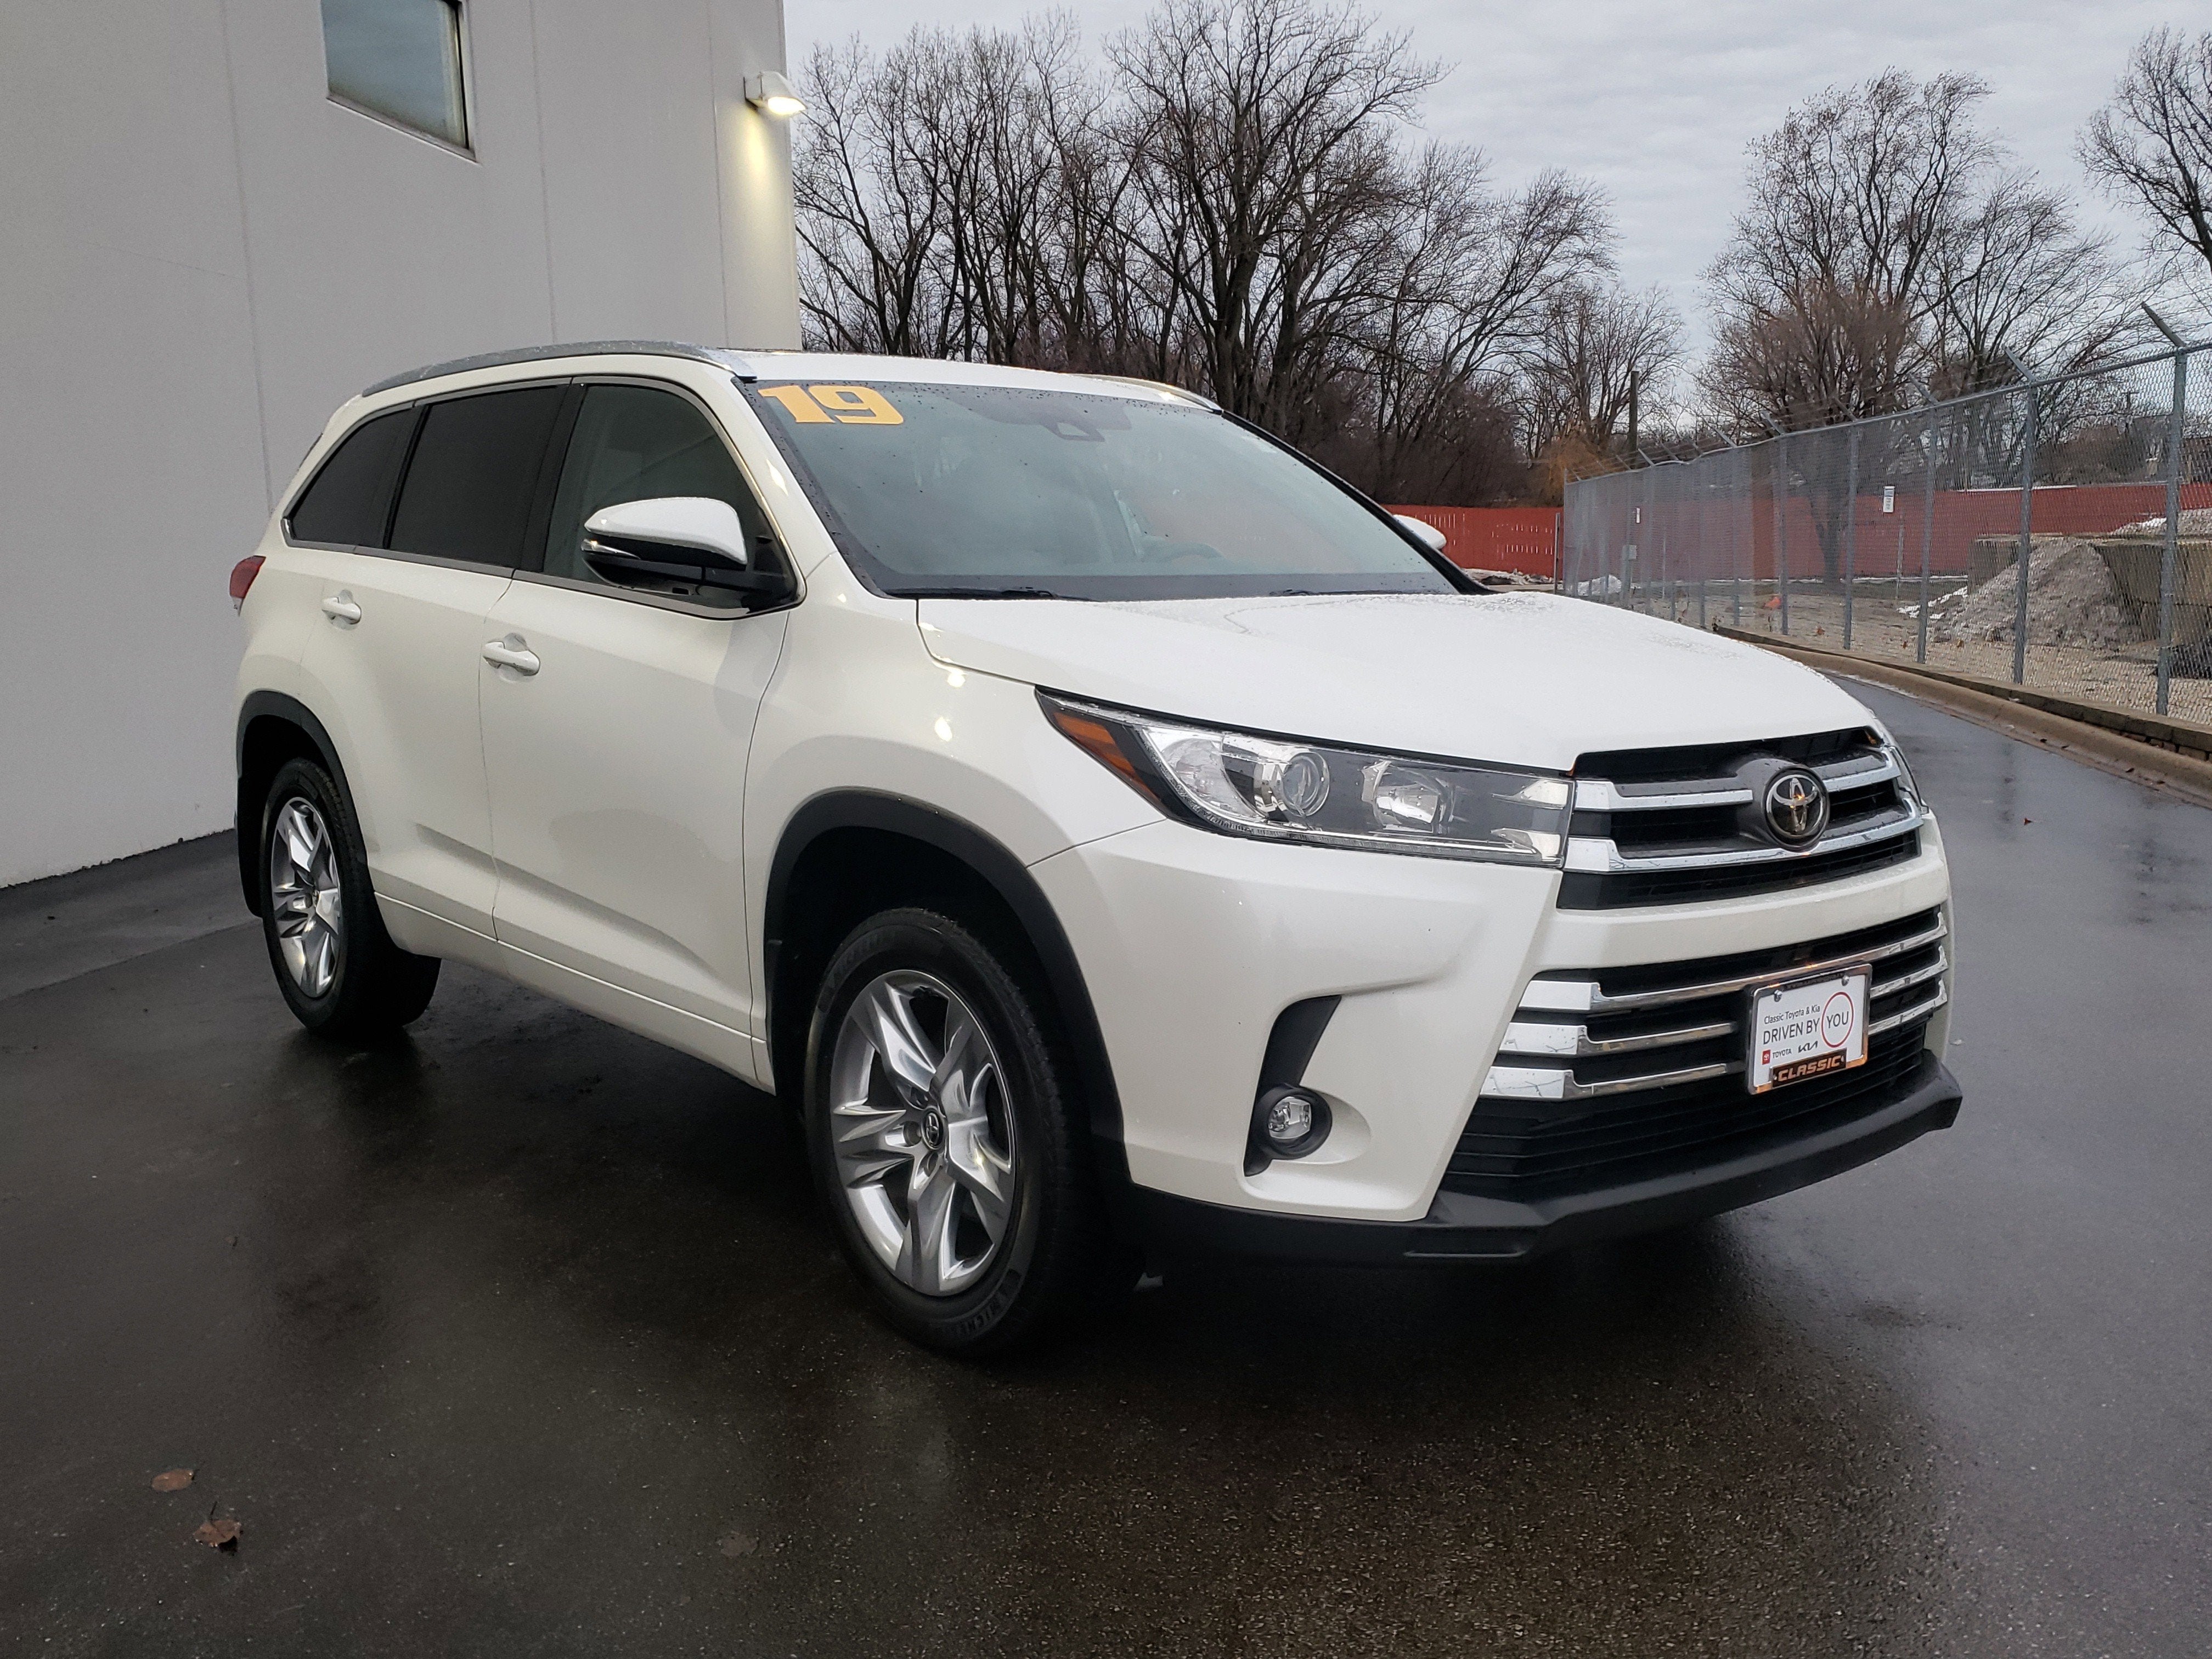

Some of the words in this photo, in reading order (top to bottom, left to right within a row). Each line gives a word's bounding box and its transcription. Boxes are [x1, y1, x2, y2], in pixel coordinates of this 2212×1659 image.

[758, 385, 904, 425] 19
[1763, 1022, 1803, 1045] DRIVEN
[1807, 1018, 1820, 1034] BY
[1826, 1011, 1849, 1029] YOU
[1764, 1013, 1784, 1025] Classic
[1785, 1008, 1804, 1020] Toyota
[1805, 1006, 1810, 1015] &
[1811, 1004, 1820, 1013] Kia
[1772, 1048, 1792, 1059] TOYOTA
[1777, 1055, 1842, 1082] CLASSIC
